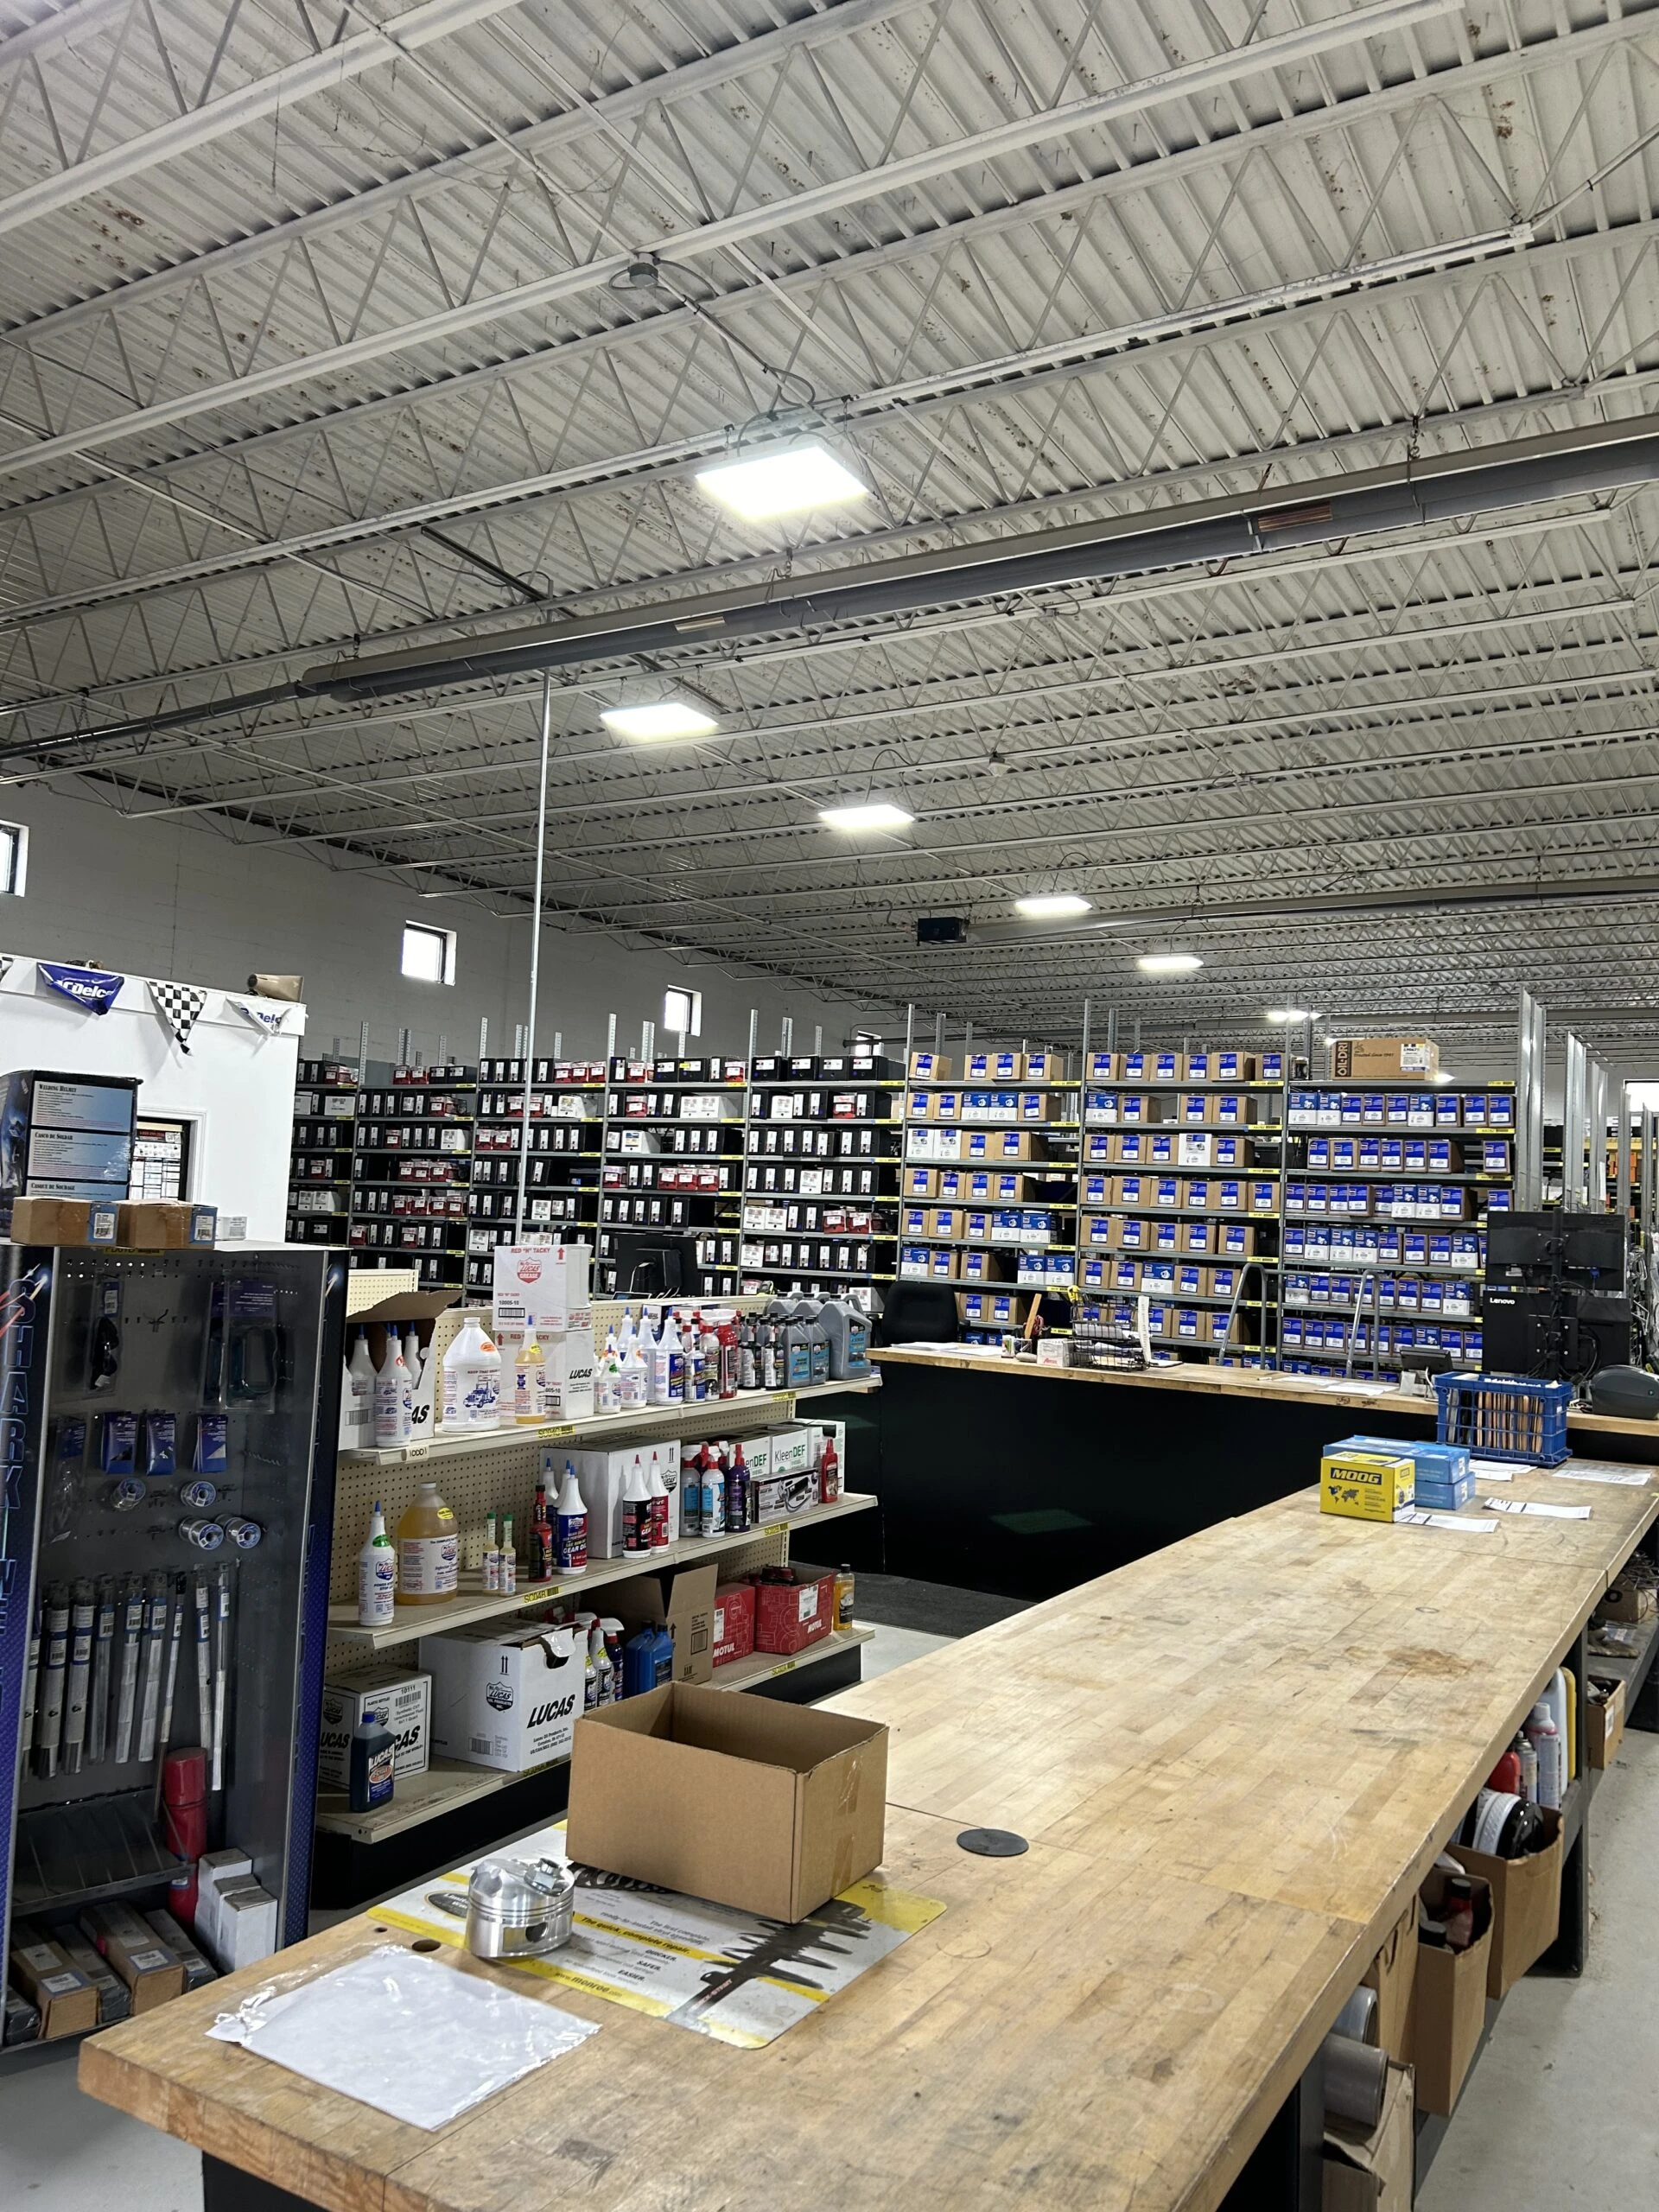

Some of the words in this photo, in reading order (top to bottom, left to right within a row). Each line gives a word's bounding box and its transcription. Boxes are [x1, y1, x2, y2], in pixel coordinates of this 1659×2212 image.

[569, 1369, 593, 1379] LUCAS
[0, 1279, 36, 1510] SHARK
[745, 1453, 767, 1468] enDEF
[774, 1444, 806, 1464] KleenDEF
[1332, 1469, 1381, 1484] MOOG
[563, 1545, 579, 1554] GEAR
[808, 1618, 823, 1634] MOTUL
[713, 1643, 735, 1659] MOTUL
[401, 1684, 416, 1694] 10111
[488, 1690, 512, 1700] LUCAS
[527, 1694, 575, 1729] LUCAS
[321, 1732, 350, 1749] UCAS
[394, 1725, 421, 1752] CAS
[443, 1892, 467, 1903] Limit
[600, 1910, 654, 1932] ready-to-install
[650, 1919, 664, 1928] The
[582, 1916, 597, 1925] The
[596, 1922, 621, 1934] quick,
[622, 1929, 663, 1945] complete
[662, 1941, 691, 1955] repair.
[645, 1948, 677, 1961] QUICKER.
[637, 1960, 662, 1971] SAFER.
[617, 1969, 645, 1981] EASIER.
